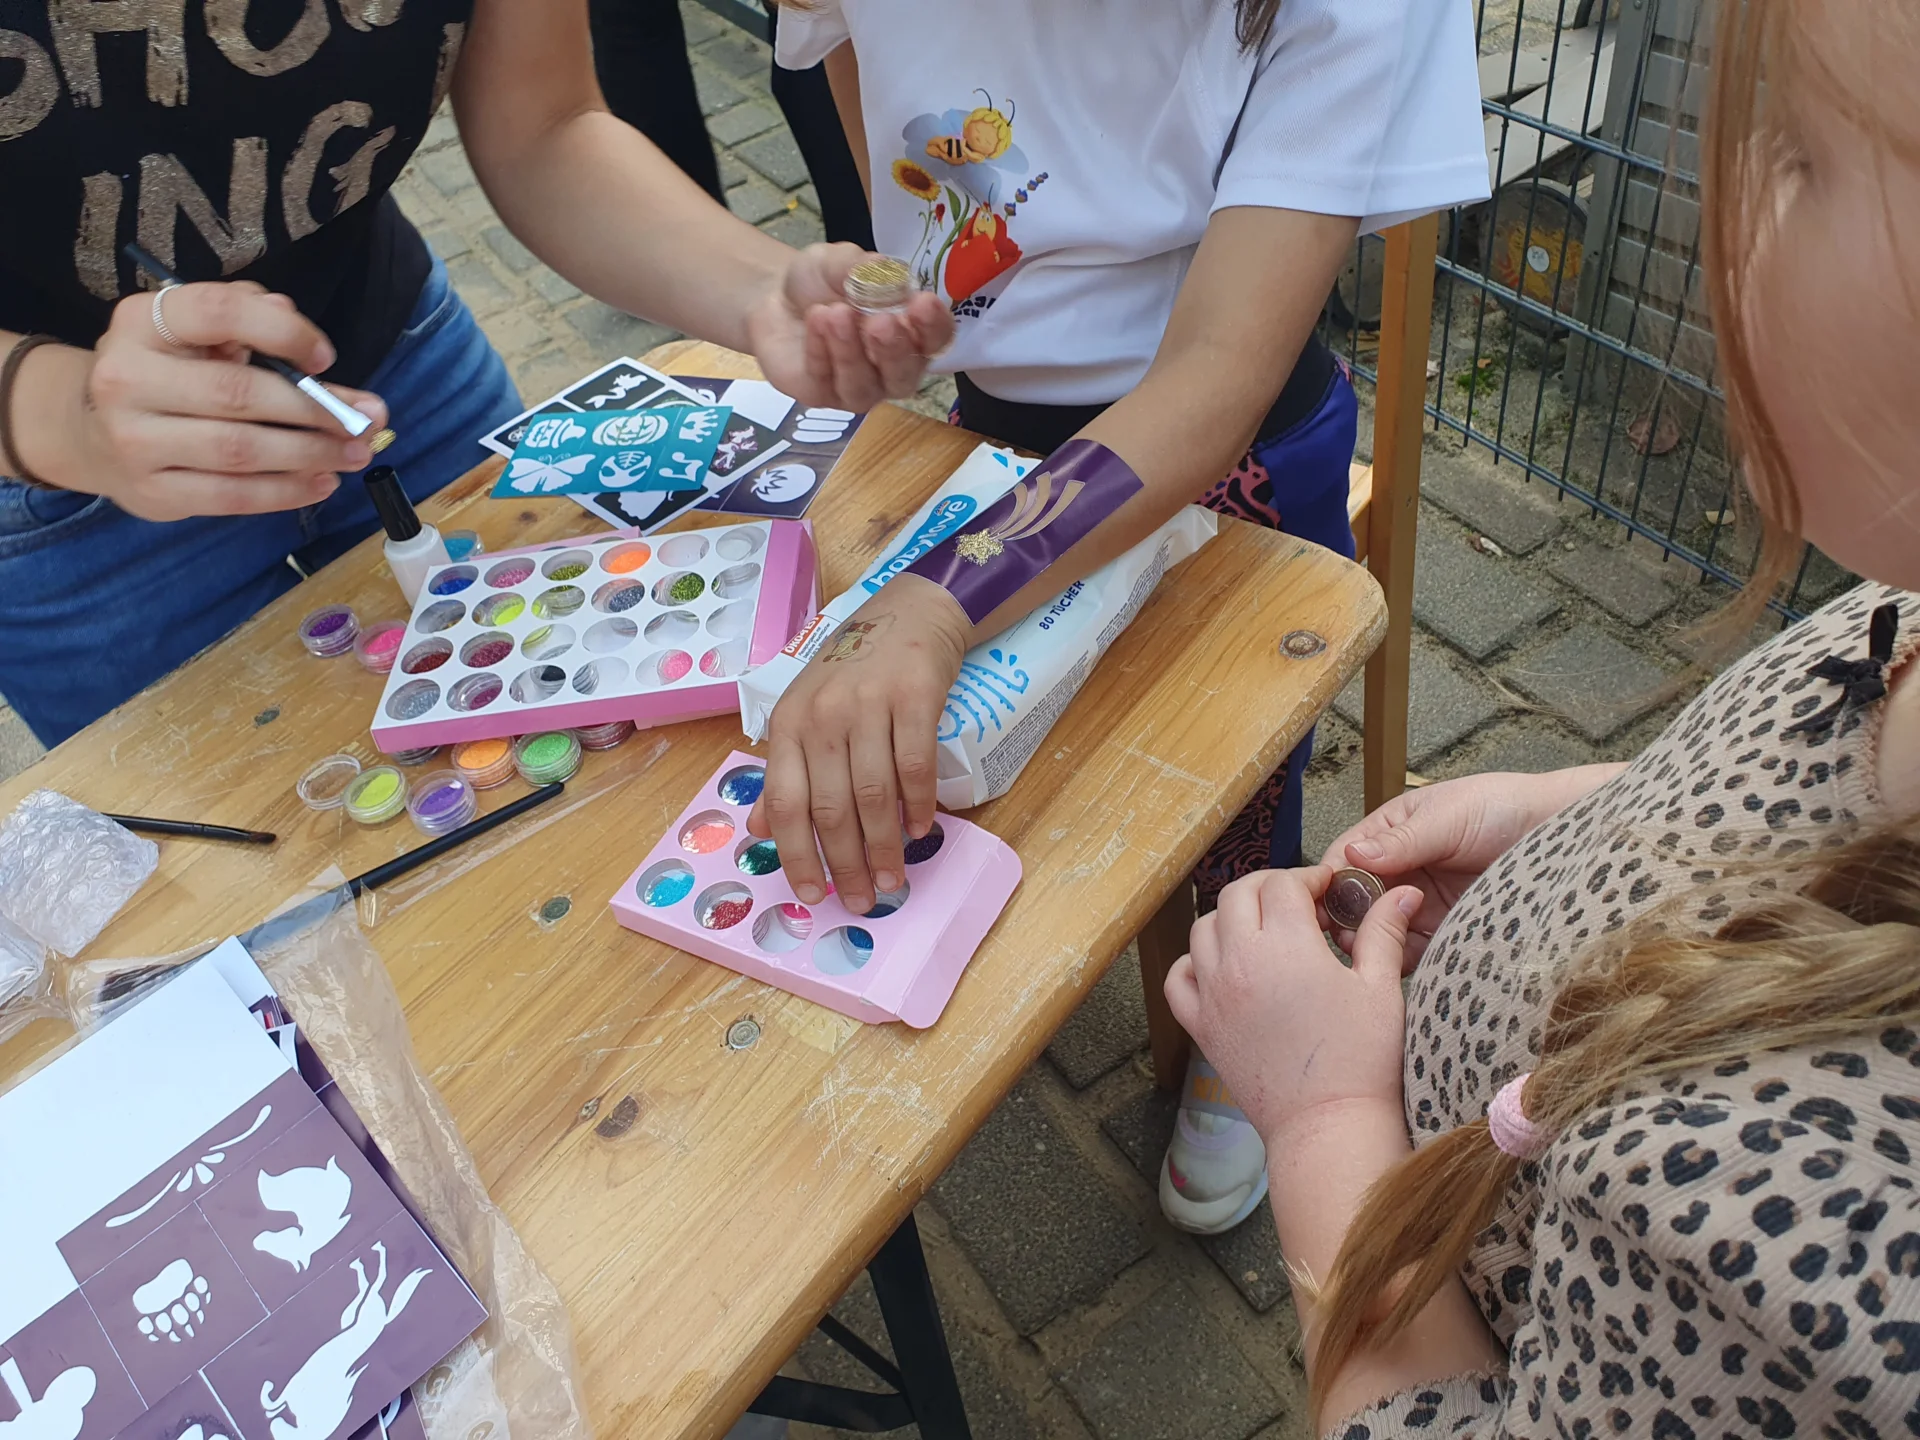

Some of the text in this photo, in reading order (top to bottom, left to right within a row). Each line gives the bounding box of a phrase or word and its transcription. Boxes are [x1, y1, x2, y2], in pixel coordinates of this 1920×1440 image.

[868, 500, 959, 588] babylove
[1038, 580, 1086, 631] 80 TÜCHER
